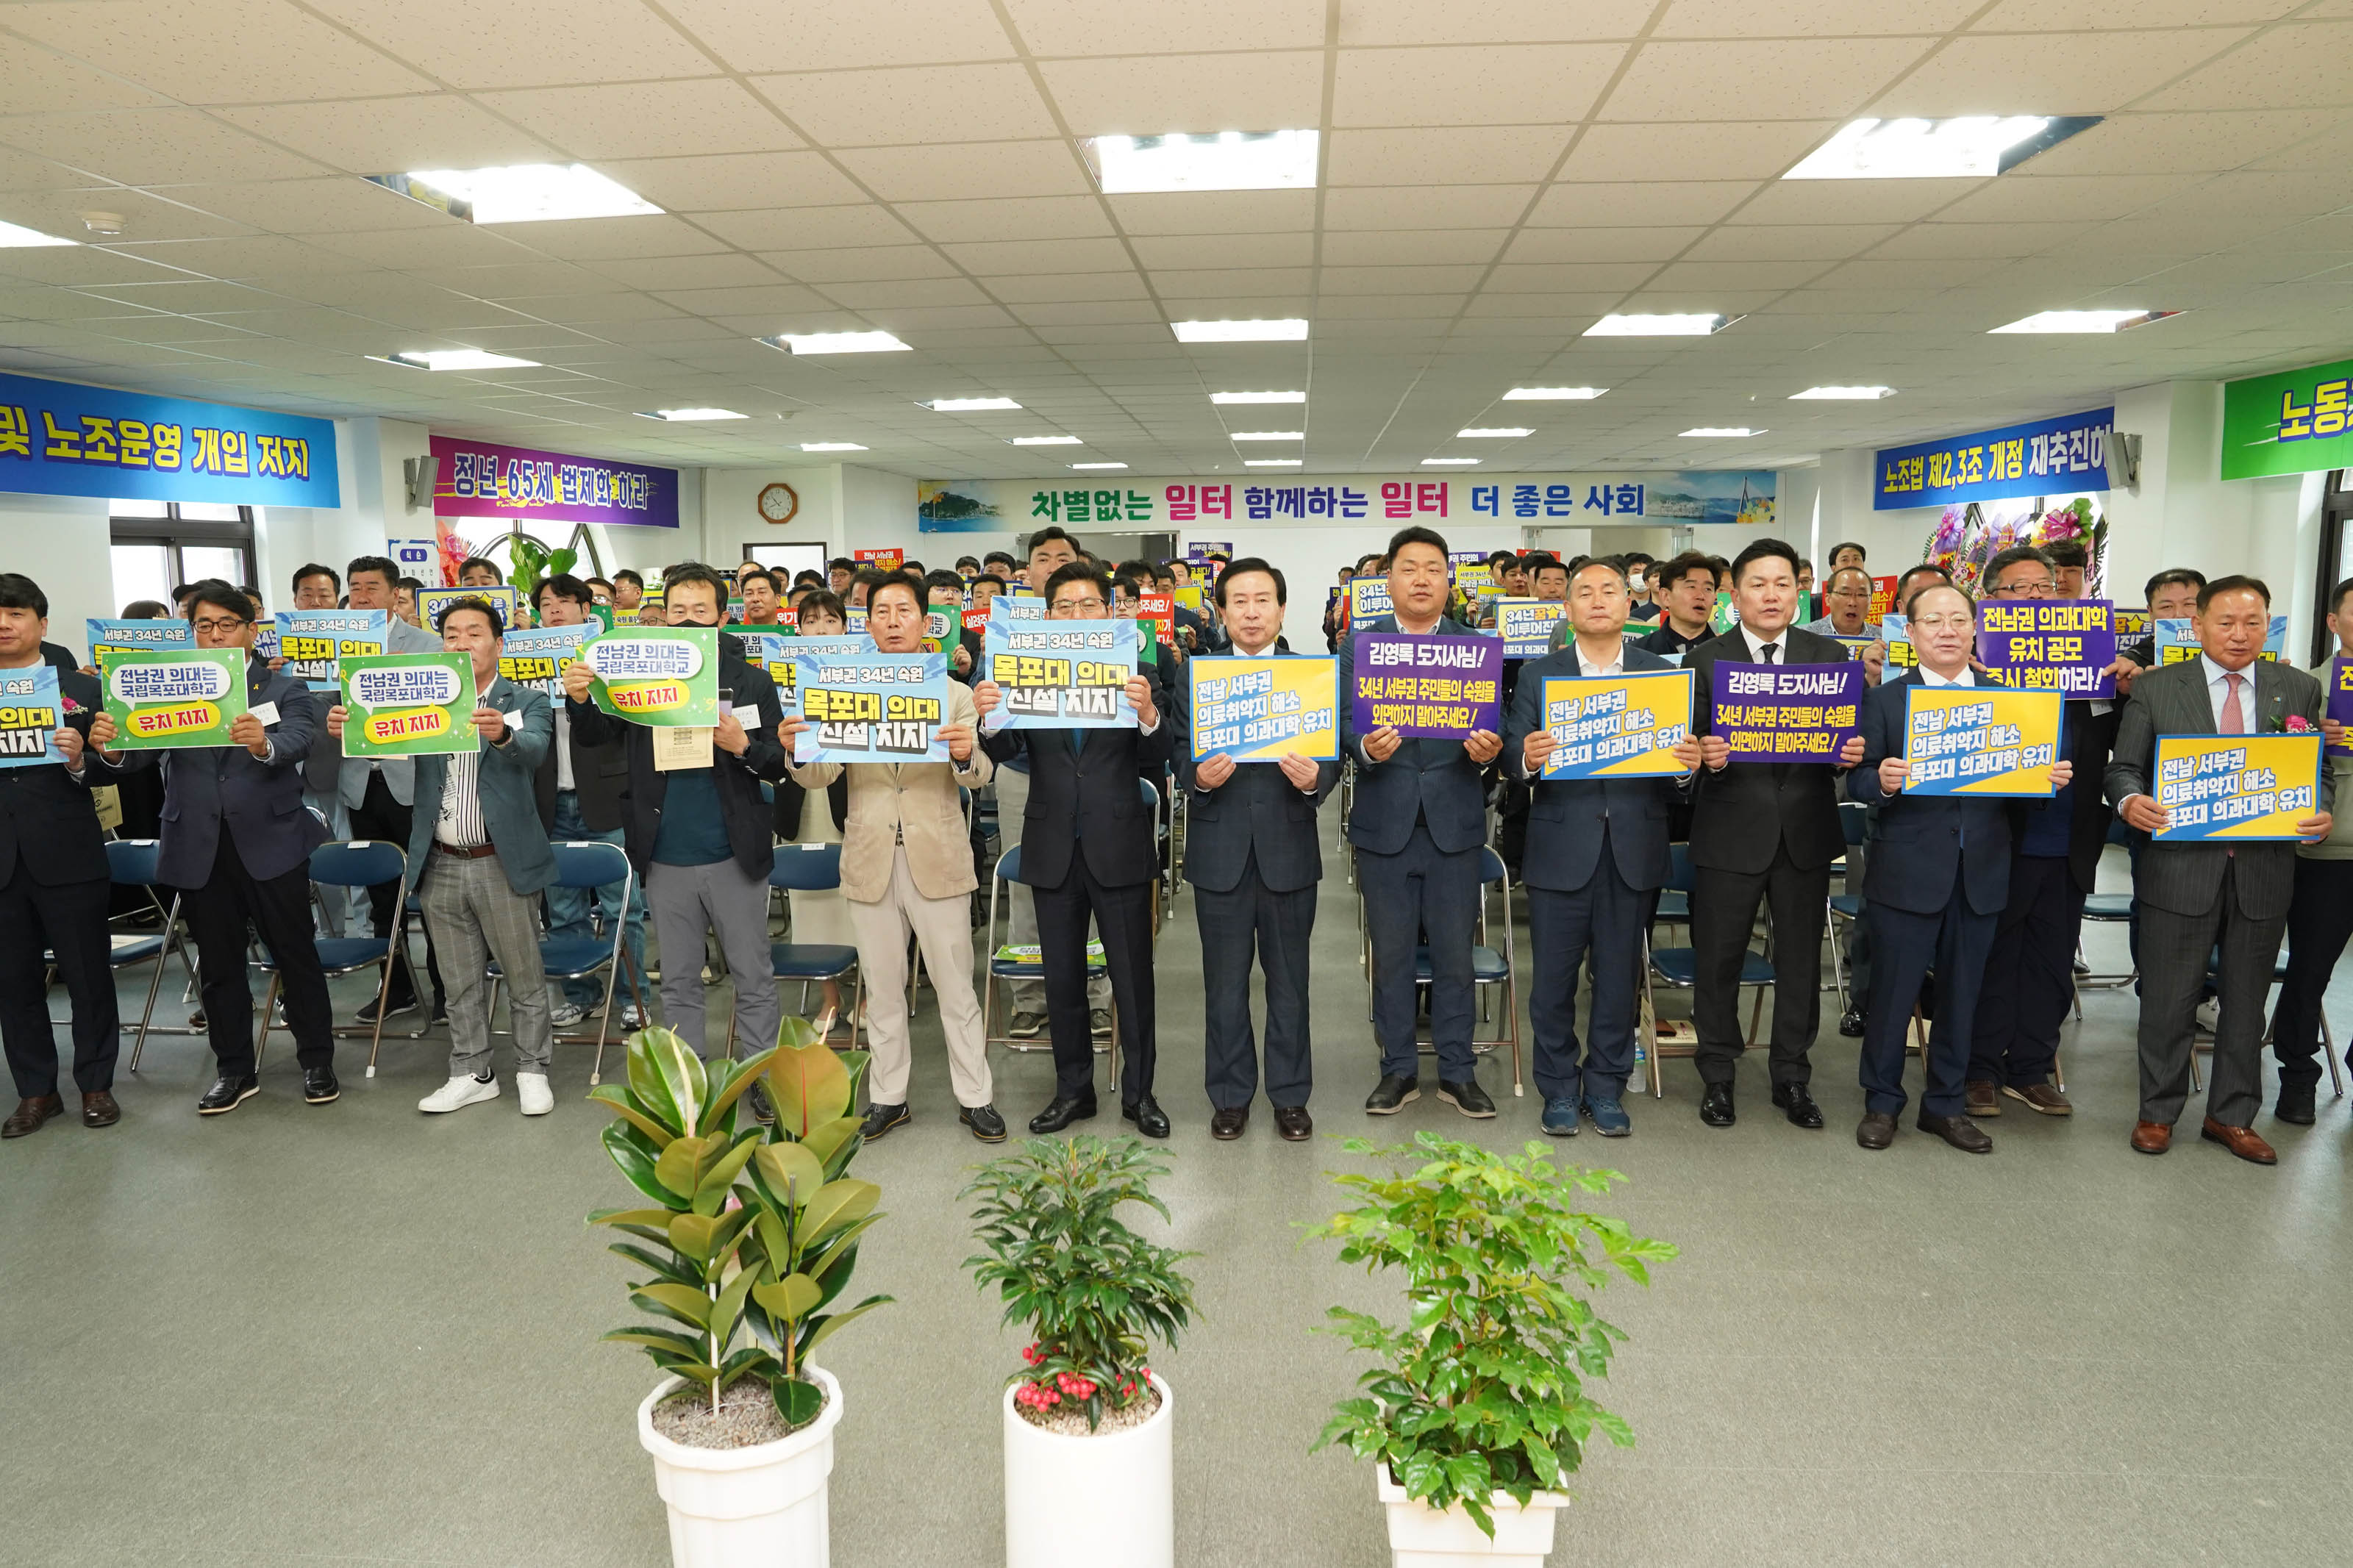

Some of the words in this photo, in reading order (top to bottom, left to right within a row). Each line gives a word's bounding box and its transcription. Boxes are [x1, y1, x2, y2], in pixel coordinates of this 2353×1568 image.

[2280, 381, 2353, 439] 노동
[0, 406, 29, 456] 및
[43, 411, 181, 468] 노조운영
[193, 428, 248, 473] 개입
[257, 435, 309, 478] 저지
[1884, 456, 1924, 493] 노조법
[1927, 445, 1983, 490] 제2,3조
[1988, 438, 2024, 481] 개정
[454, 452, 499, 499] 정년
[507, 459, 554, 504] 65세
[561, 465, 612, 507] 법제화
[618, 471, 648, 509] 하라
[1031, 490, 1153, 522] 차별없는
[1165, 484, 1232, 520] 일터
[1244, 486, 1368, 519] 함께하는
[1381, 482, 1448, 518] 일터
[1472, 485, 1499, 517] 더
[1512, 484, 1573, 517] 좋은
[1583, 484, 1644, 516] 사회
[1009, 606, 1040, 620] 서부권
[1984, 606, 2036, 632] 전남권
[2039, 606, 2107, 631] 의과대학
[104, 629, 133, 642] 서부권
[135, 629, 163, 641] 34년
[165, 629, 186, 642] 숙원
[290, 620, 317, 632] 서부권
[318, 620, 346, 631] 34년
[349, 619, 369, 631] 숙원
[281, 637, 335, 658] 목포대
[340, 640, 381, 656] 의대
[507, 640, 533, 654] 서부권
[536, 637, 561, 651] 34년
[563, 634, 583, 647] 숙원
[596, 645, 640, 659] 전남권
[645, 645, 690, 659] 의대는
[779, 645, 809, 658] 서부권
[1008, 633, 1046, 649] 서부권
[1049, 633, 1084, 648] 34년
[1087, 632, 1113, 648] 숙원
[2010, 637, 2043, 662] 유치
[2048, 637, 2082, 662] 공모
[1370, 642, 1414, 665] 김영록
[1417, 644, 1487, 668] 도지사님!
[121, 668, 165, 684] 전남권
[171, 667, 216, 682] 의대는
[292, 661, 326, 679] 신설
[499, 658, 555, 681] 목포대
[597, 661, 689, 674] 국립목포대학교
[818, 667, 857, 683] 서부권
[860, 667, 894, 683] 34년
[897, 666, 924, 683] 숙원
[993, 654, 1071, 687] 목포대
[1076, 661, 1129, 686] 의대
[5, 679, 35, 695] 숙원
[121, 682, 218, 698] 국립목포대학교
[360, 673, 400, 689] 전남권
[405, 671, 448, 686] 의대는
[1197, 679, 1227, 704] 전남
[1229, 669, 1272, 696] 서부권
[1358, 677, 1383, 699] 34년
[1385, 677, 1417, 700] 서부권
[1419, 679, 1461, 702] 주민들의
[1463, 680, 1496, 703] 숙원을
[1729, 671, 1775, 695] 김영록
[1777, 672, 1848, 695] 도지사님!
[362, 687, 449, 701] 국립목포대학교
[614, 691, 642, 706] 유치
[646, 687, 677, 704] 지지
[804, 687, 881, 721] 목포대
[887, 695, 940, 721] 의대
[1007, 687, 1058, 712] 신설
[1065, 687, 1116, 715] 지지
[1549, 698, 1580, 723] 전남
[1582, 689, 1627, 716] 서부권
[0, 707, 54, 729] 의대
[138, 715, 172, 731] 유치
[175, 709, 210, 726] 지지
[1197, 695, 1268, 727] 의료취약지
[1271, 691, 1300, 714] 해소
[1372, 704, 1415, 726] 외면하지
[1417, 705, 1478, 728] 말아주세요!
[1716, 704, 1742, 726] 34년
[1743, 706, 1777, 727] 서부권
[1779, 706, 1823, 728] 주민들의
[1824, 705, 1856, 727] 숙원을
[1913, 709, 1945, 734] 전남
[1946, 701, 1993, 728] 서부권
[375, 720, 405, 737] 유치
[409, 714, 440, 731] 지지
[818, 721, 869, 746] 신설
[876, 721, 928, 749] 지지
[1197, 726, 1240, 751] 목포대
[1243, 714, 1301, 743] 의과대학
[1303, 708, 1332, 734] 유치
[1549, 714, 1621, 745] 의료취약지
[1624, 708, 1654, 731] 해소
[1549, 744, 1592, 768] 목포대
[1596, 731, 1653, 760] 의과대학
[1656, 723, 1685, 749] 유치
[1729, 731, 1774, 752] 외면하지
[1775, 732, 1838, 753] 말아주세요!
[1911, 728, 1987, 758] 의료취약지
[1990, 723, 2021, 747] 해소
[1910, 758, 1955, 783] 목포대
[1959, 748, 2020, 777] 의과대학
[2021, 743, 2052, 768] 유치
[2163, 756, 2196, 781] 전남
[2197, 748, 2246, 775] 서부권
[2161, 773, 2239, 806] 의료취약지
[2243, 767, 2276, 792] 해소
[2213, 792, 2276, 821] 의과대학
[2279, 785, 2312, 812] 유치
